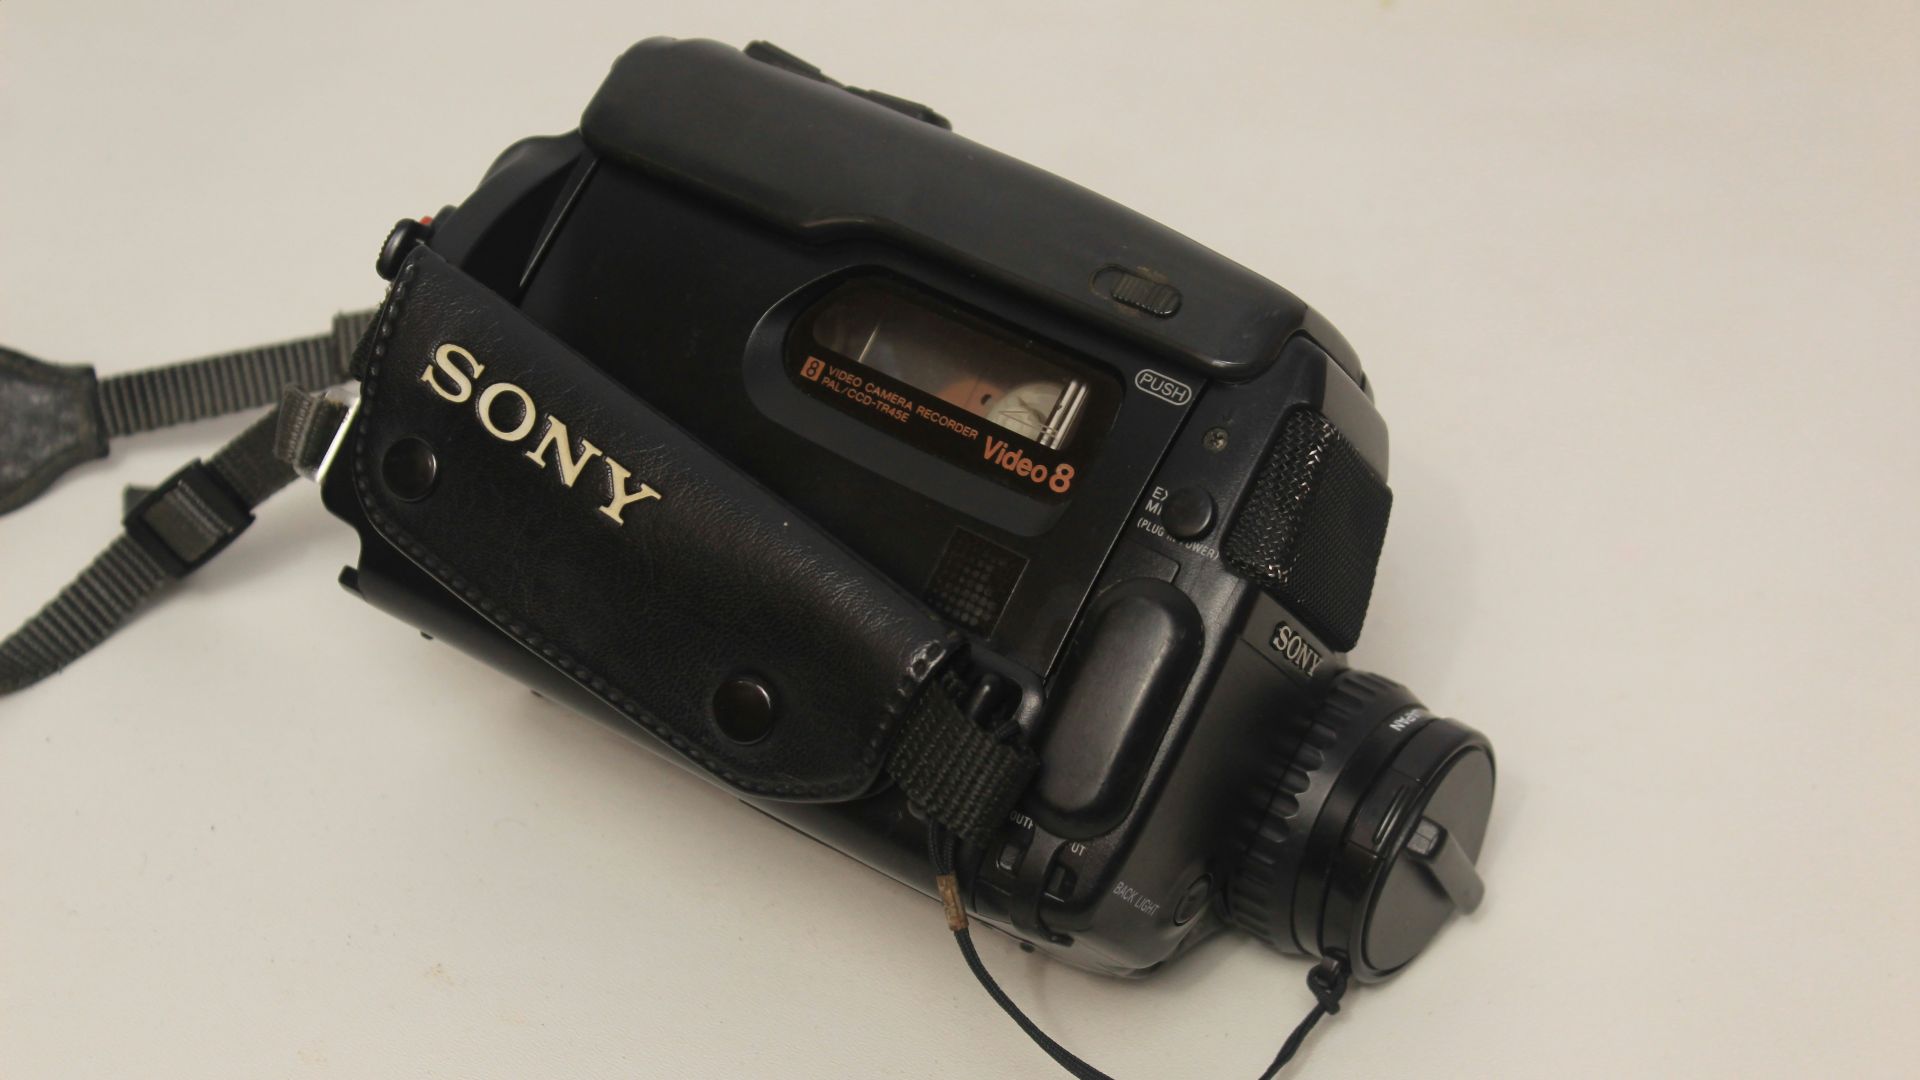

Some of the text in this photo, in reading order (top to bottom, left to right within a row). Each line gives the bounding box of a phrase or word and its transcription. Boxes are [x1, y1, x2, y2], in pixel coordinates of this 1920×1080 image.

[821, 376, 910, 423] PAL/CCD-TR45E
[828, 365, 980, 441] VIDEO CAMERA RECORDER
[1139, 373, 1187, 401] PUSH
[420, 343, 662, 526] SONY
[1137, 517, 1219, 560] (PLUG OWER)
[1273, 625, 1323, 677] SONY
[1071, 842, 1086, 856] UT
[1113, 881, 1161, 917] BACK LIGHT
